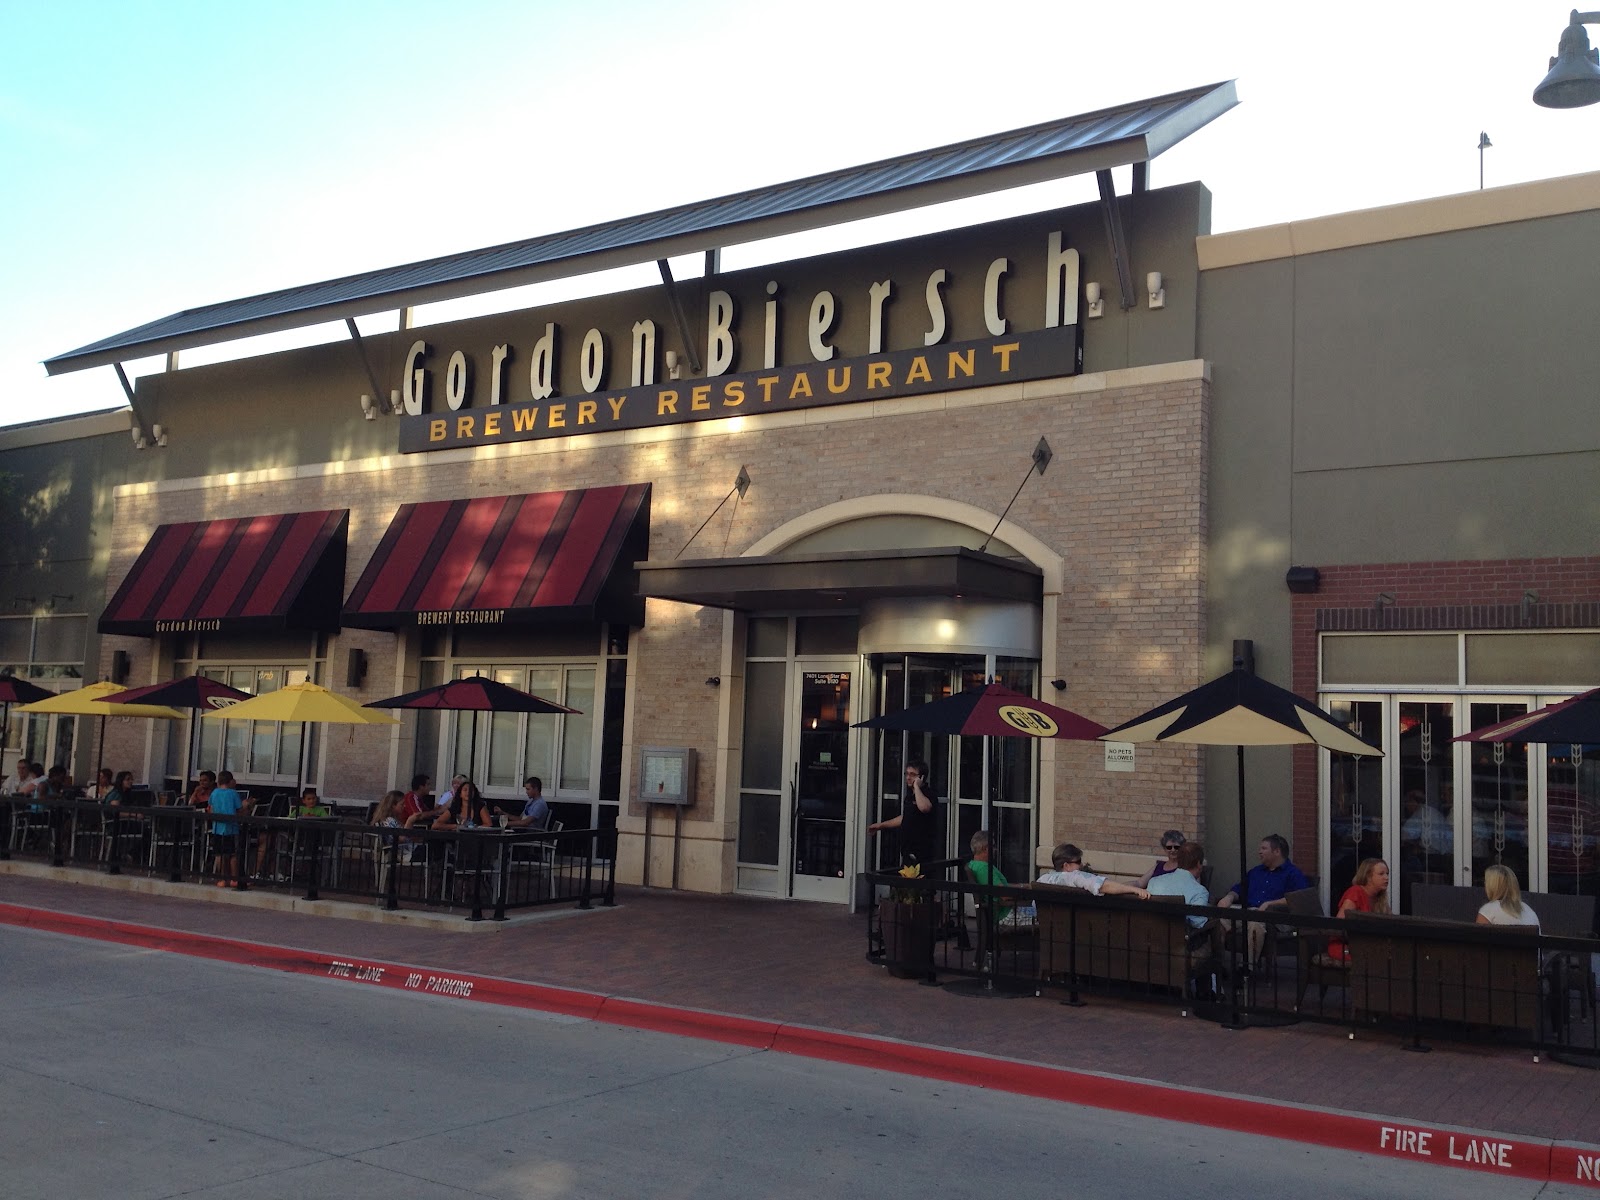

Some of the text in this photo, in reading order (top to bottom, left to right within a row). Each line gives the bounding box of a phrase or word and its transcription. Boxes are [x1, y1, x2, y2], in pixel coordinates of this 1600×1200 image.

[403, 231, 1080, 416] Gordon Biersch
[429, 342, 1020, 442] BREWERY RESTAURANT
[155, 618, 220, 632] Gordon Biersch
[417, 610, 505, 625] BREWERY RESTAURANT
[328, 961, 385, 982] FIRE LANE
[405, 972, 474, 997] NO PARKING
[1380, 1126, 1512, 1168] FIRE LANE
